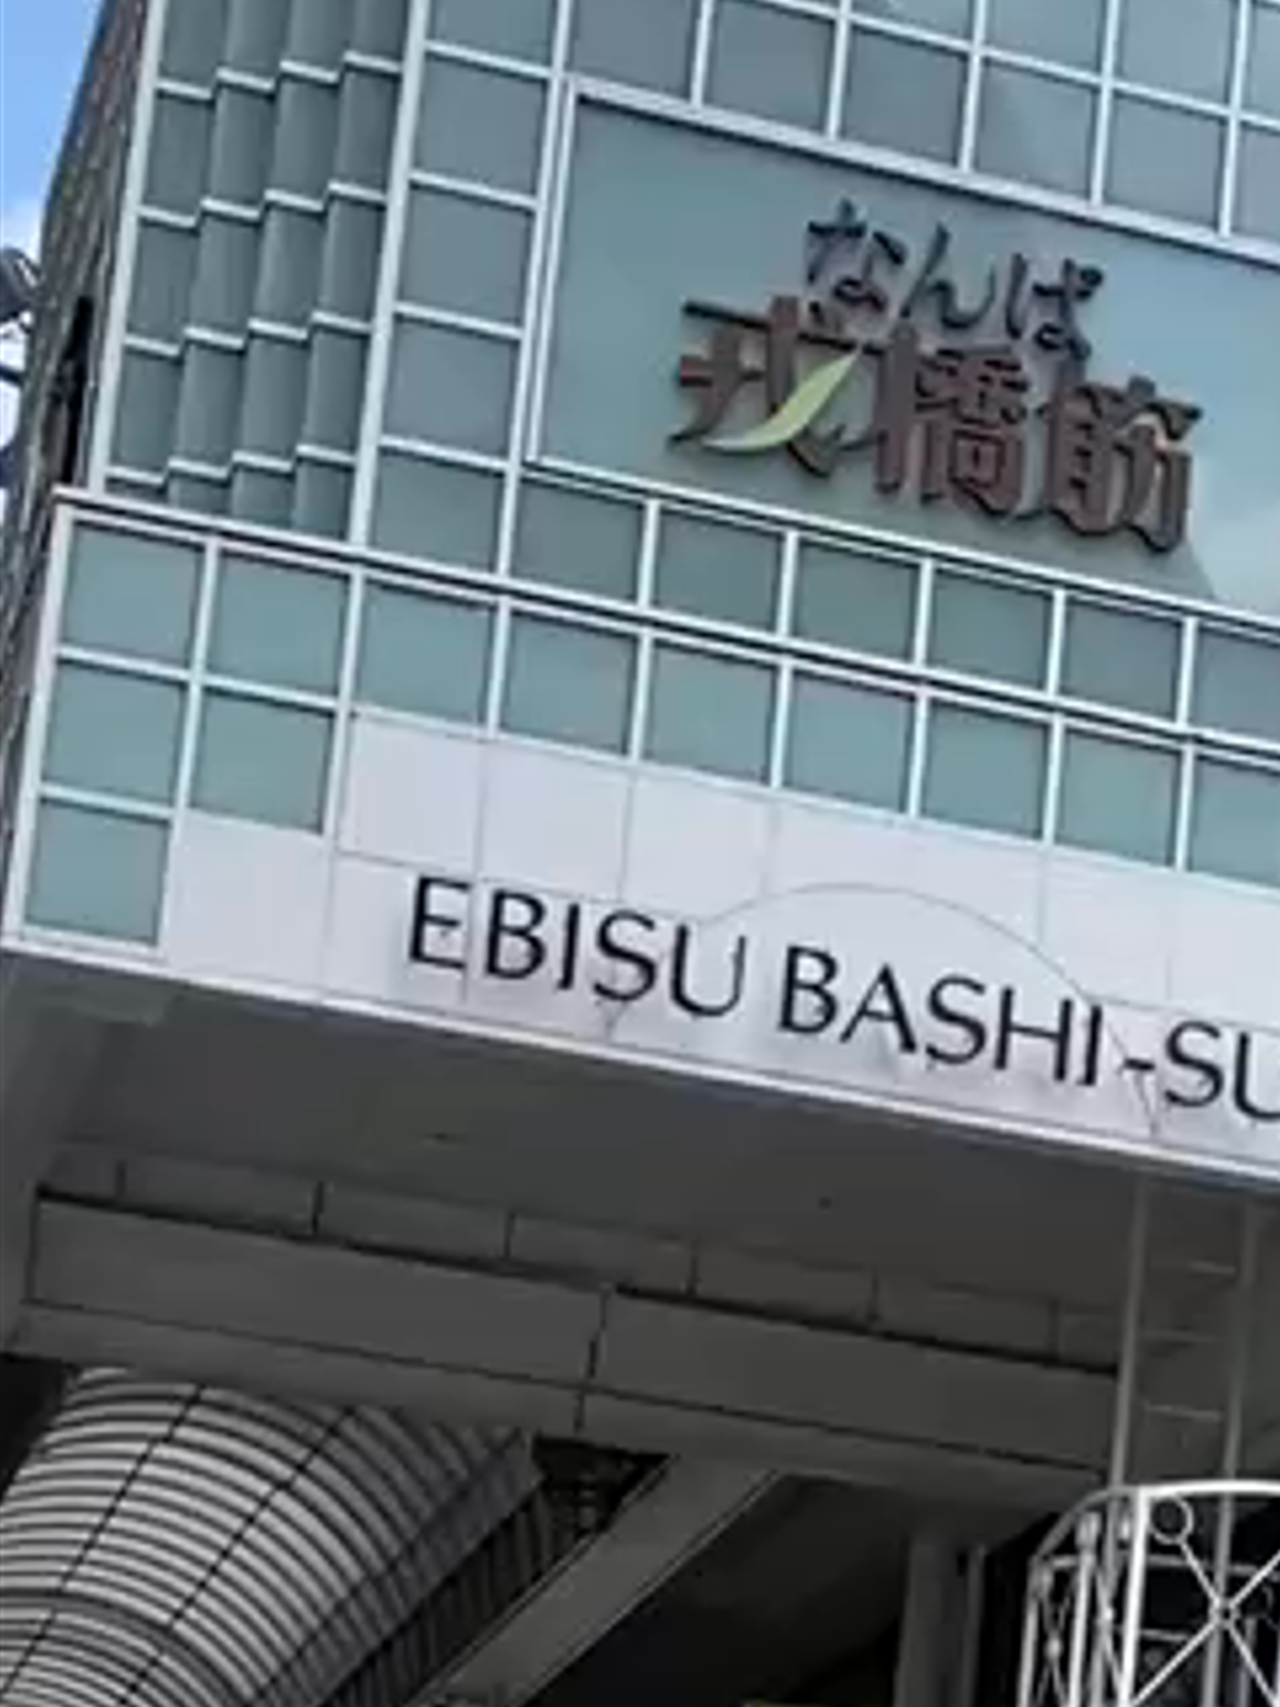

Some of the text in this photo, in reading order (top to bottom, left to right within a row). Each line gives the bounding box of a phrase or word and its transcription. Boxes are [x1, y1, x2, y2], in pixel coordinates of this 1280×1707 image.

[805, 198, 1104, 361] なんば
[668, 295, 1202, 553] 戎橋筋
[407, 875, 747, 1019] EBISU
